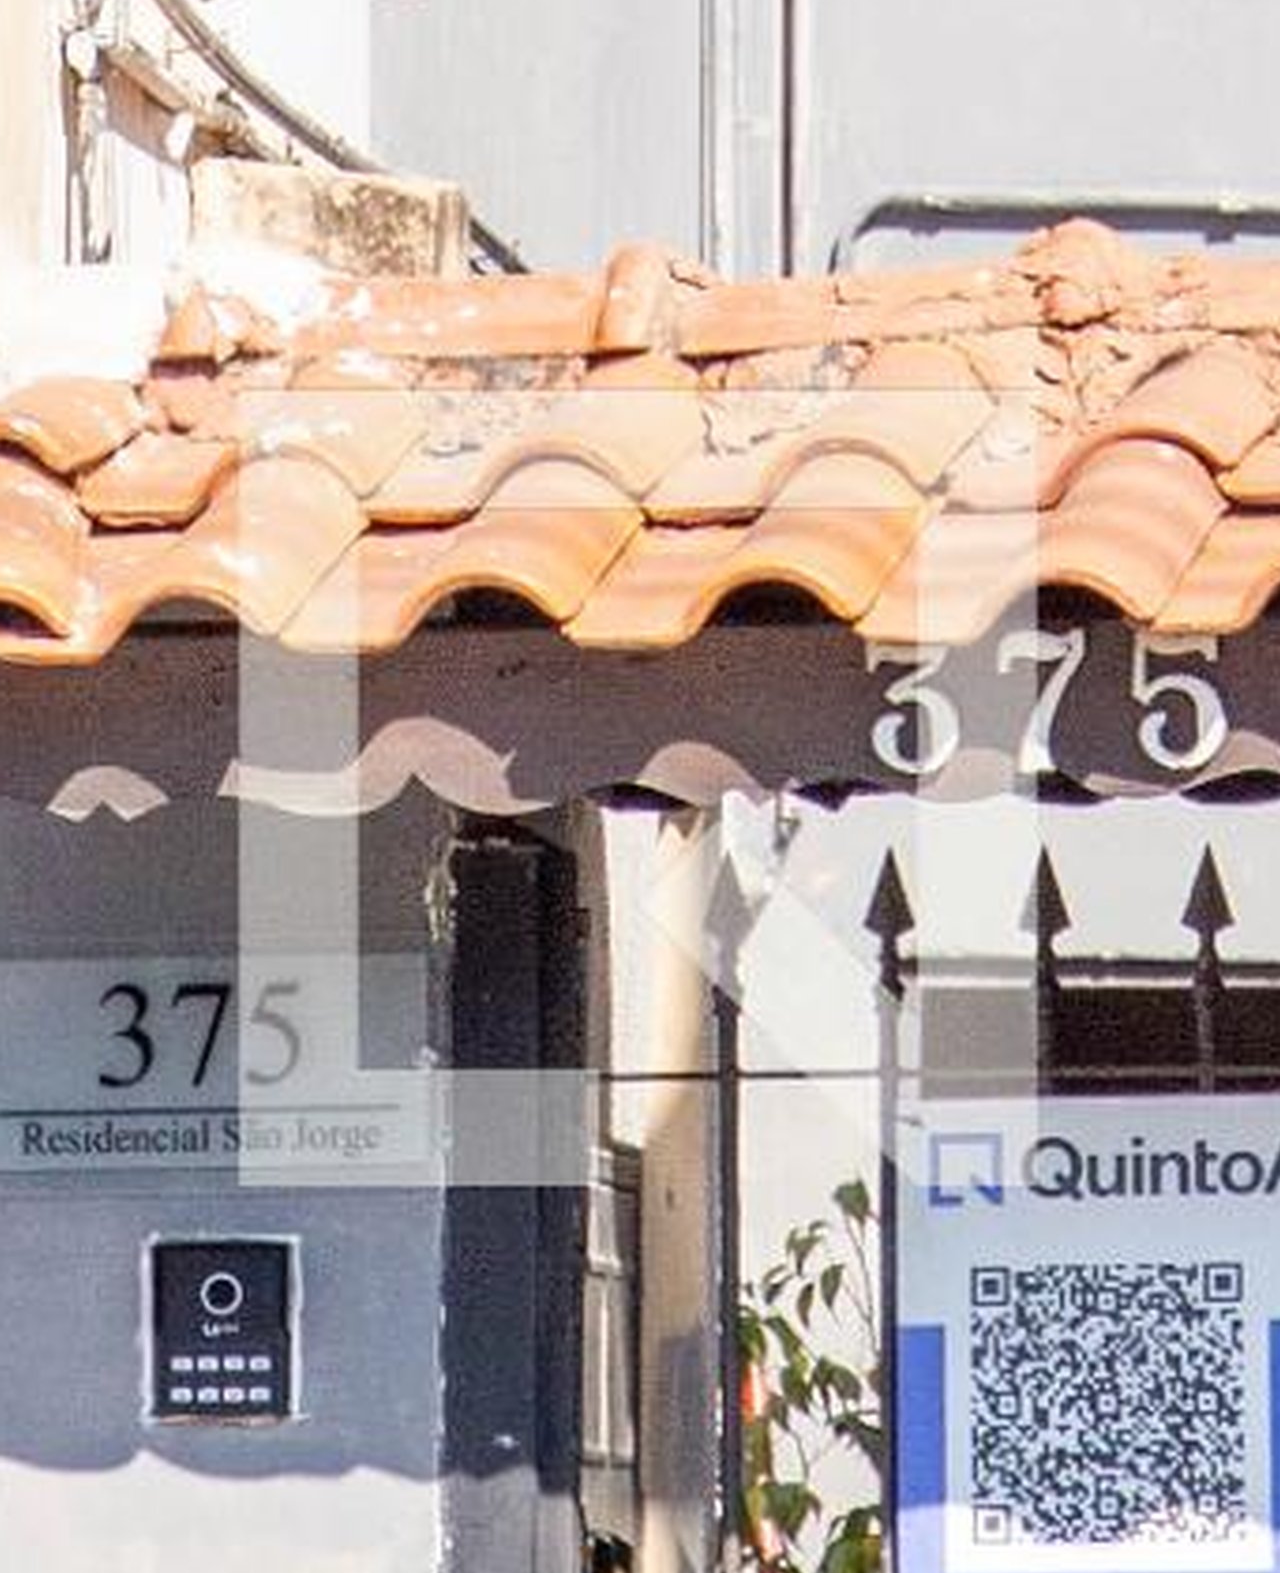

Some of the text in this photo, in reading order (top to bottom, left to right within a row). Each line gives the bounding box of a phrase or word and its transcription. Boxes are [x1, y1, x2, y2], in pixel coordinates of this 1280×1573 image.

[867, 629, 1227, 773] 375
[99, 983, 301, 1087] 375
[22, 1120, 210, 1155] Residencial
[291, 1117, 383, 1157] Jorge
